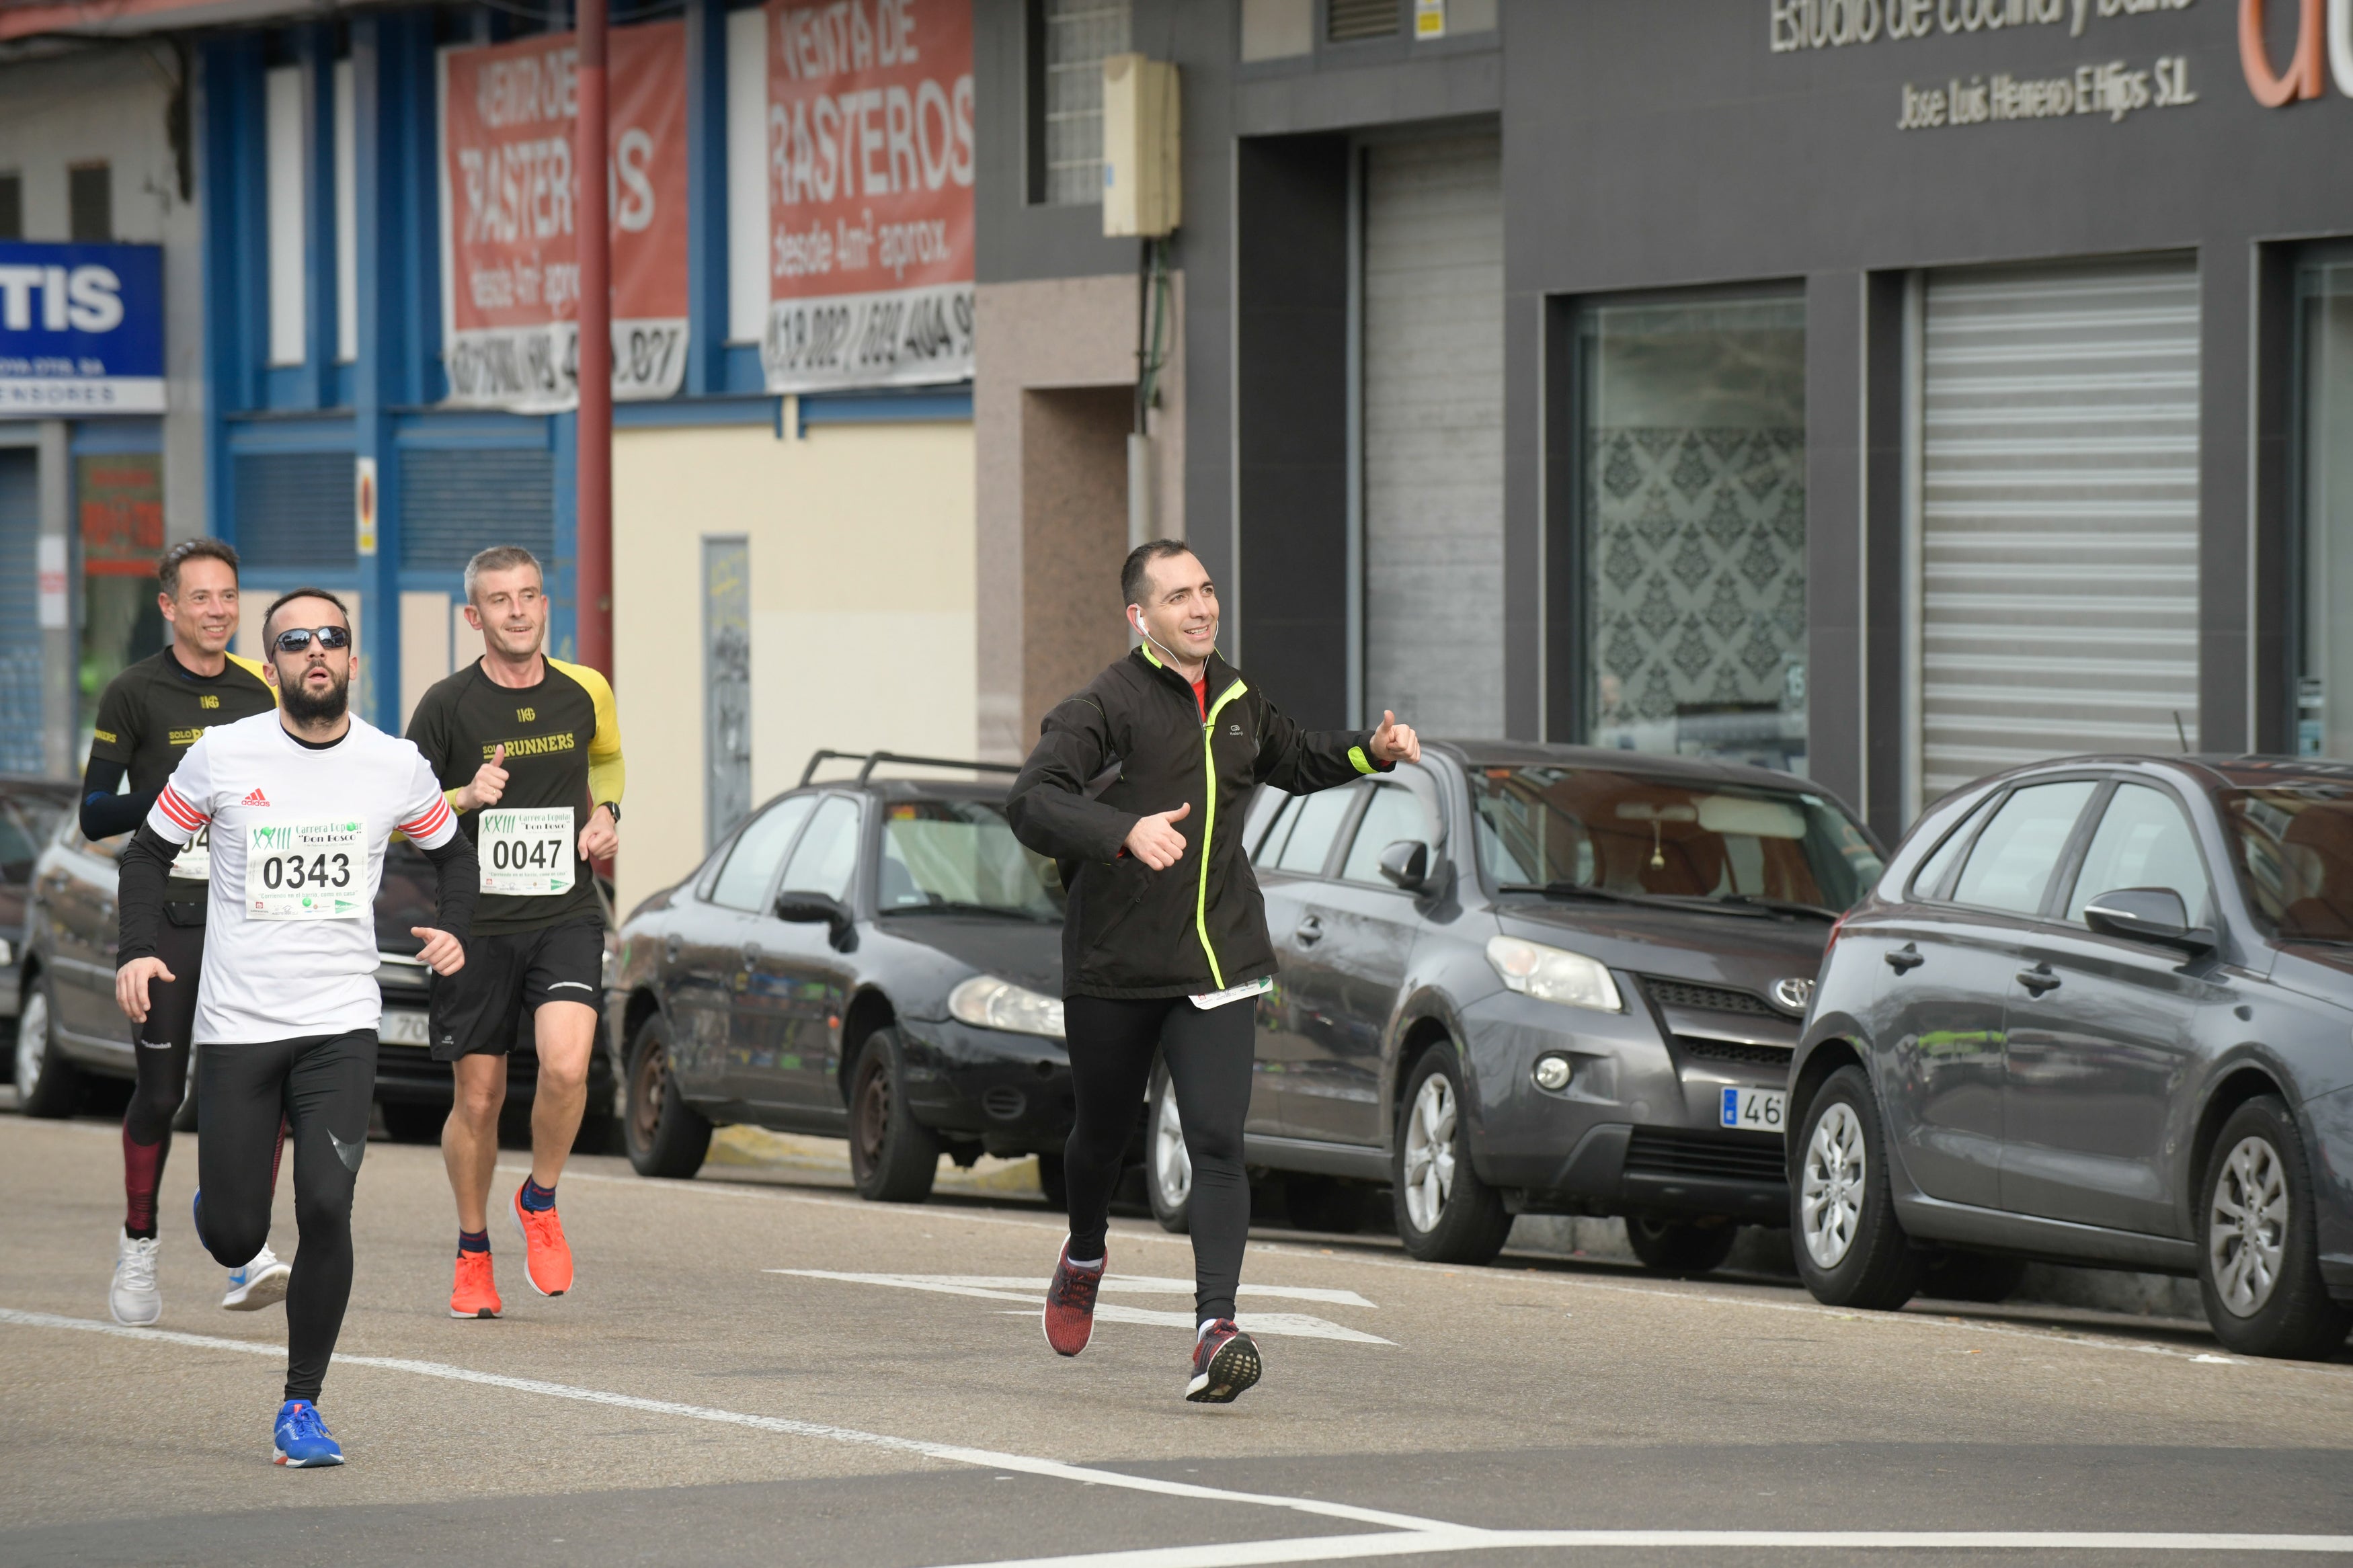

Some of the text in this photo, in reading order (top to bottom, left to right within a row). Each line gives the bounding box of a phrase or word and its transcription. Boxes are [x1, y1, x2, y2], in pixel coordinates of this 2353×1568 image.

[781, 0, 919, 79] VENTA DE
[769, 74, 974, 204] RASTEROS
[169, 731, 191, 739] SOLO
[482, 733, 575, 757] SOL RUNNERS
[241, 799, 270, 807] adidas
[252, 827, 292, 850] XXIII
[296, 825, 328, 835] Carrera
[331, 822, 363, 833] Popar
[482, 814, 516, 834] XXIII
[493, 839, 562, 870] 0047
[263, 853, 351, 889] 0343
[1744, 1094, 1781, 1125] 46
